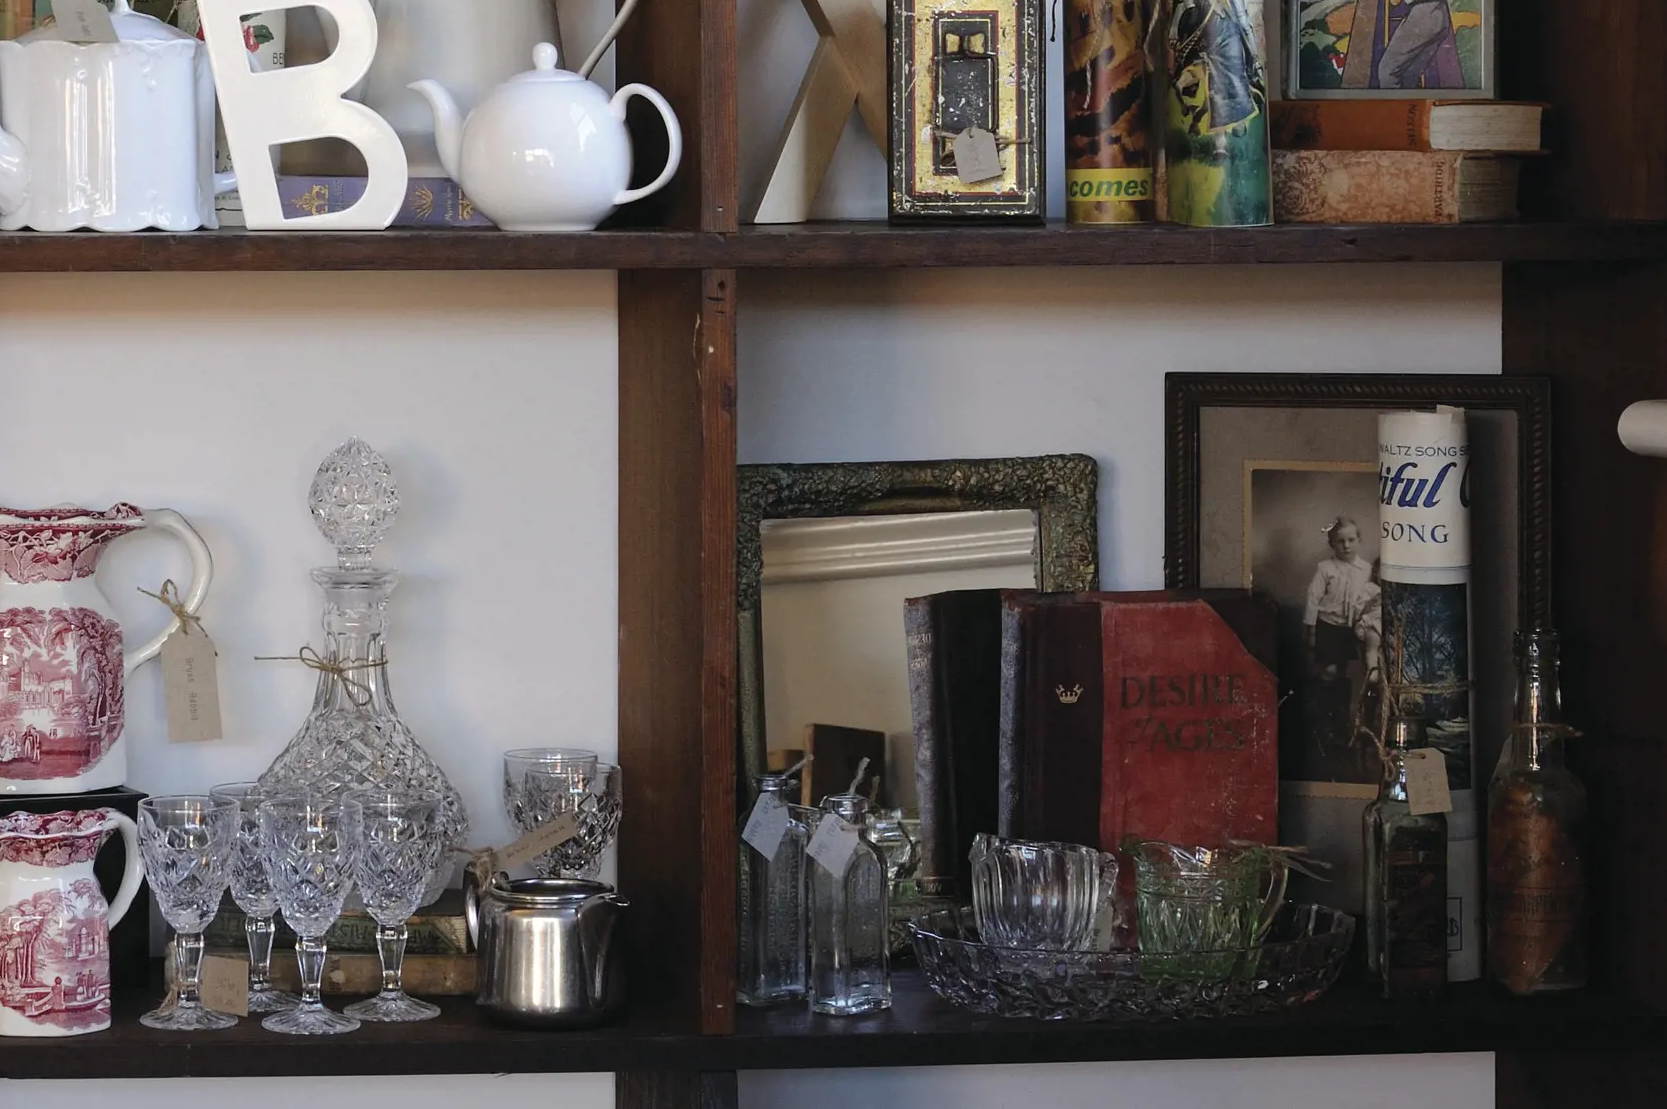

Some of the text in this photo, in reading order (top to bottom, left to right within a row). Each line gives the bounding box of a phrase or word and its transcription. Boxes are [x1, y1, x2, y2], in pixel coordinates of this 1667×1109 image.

[1069, 177, 1148, 198] comes
[1415, 445, 1458, 457] SONG
[1381, 521, 1450, 544] SONG
[1119, 672, 1249, 711] DESIRE
[1147, 719, 1246, 753] AGES
